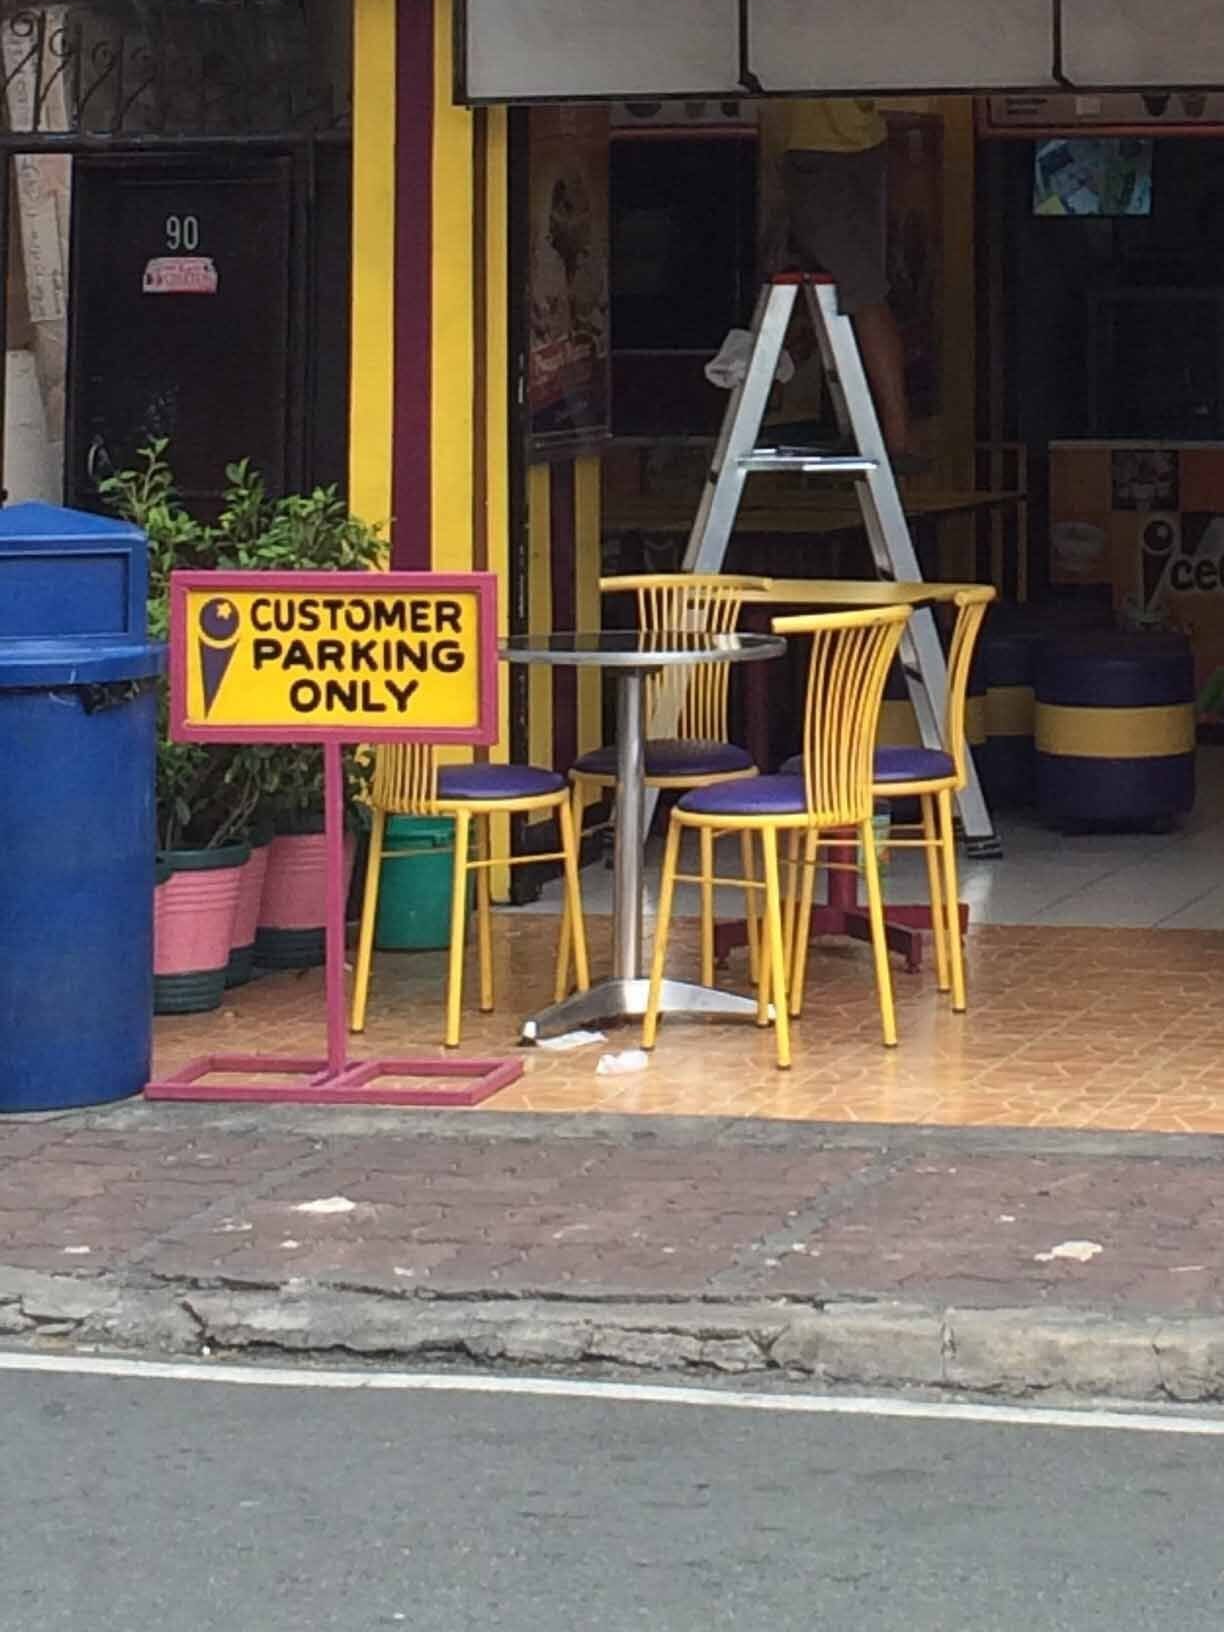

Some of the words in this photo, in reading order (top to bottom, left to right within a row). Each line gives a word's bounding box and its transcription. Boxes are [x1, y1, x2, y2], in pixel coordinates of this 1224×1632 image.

[165, 215, 199, 250] 90
[250, 598, 462, 633] CUSTOMER
[253, 638, 465, 672] PARKING
[290, 679, 419, 713] ONLY
